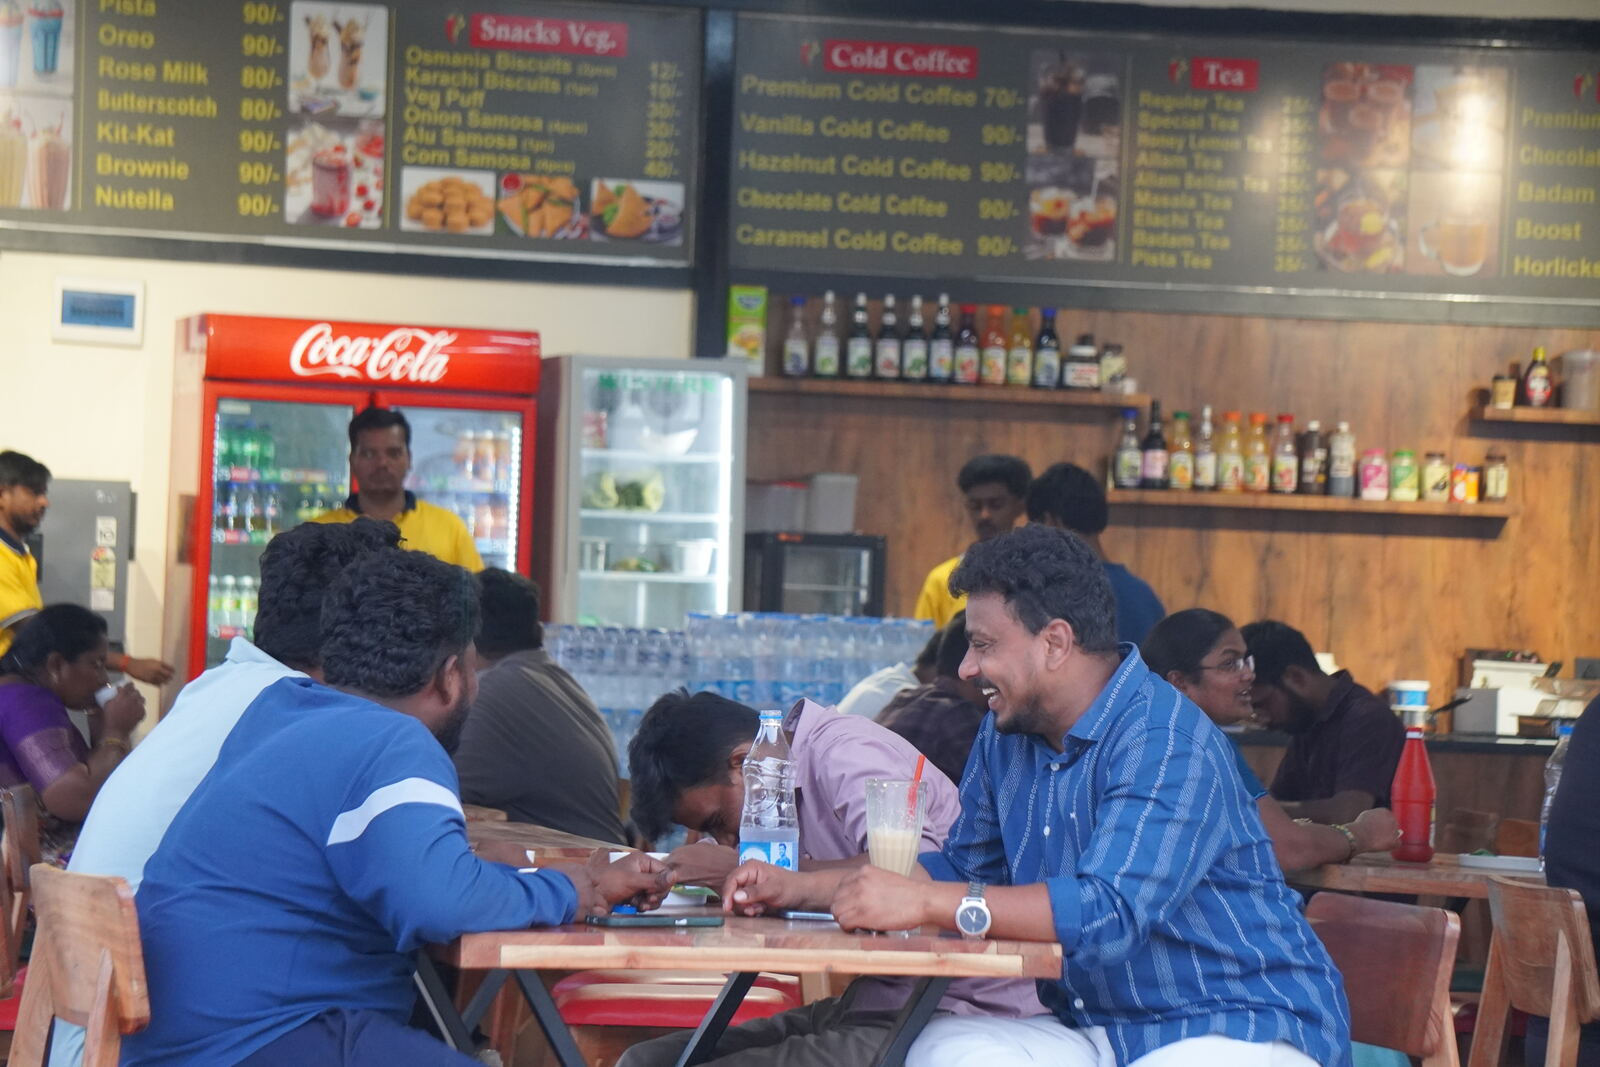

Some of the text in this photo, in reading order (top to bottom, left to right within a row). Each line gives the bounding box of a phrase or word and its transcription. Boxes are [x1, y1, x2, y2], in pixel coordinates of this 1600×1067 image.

[243, 2, 284, 25] 90/-
[99, 24, 284, 57] Oreo 90/-
[480, 17, 617, 53] Snacks Veg.
[98, 56, 283, 89] Rose Milk 80/-
[405, 45, 491, 69] Osmania
[495, 50, 573, 74] Biscuits
[830, 44, 973, 75] Cold Coffee
[1204, 62, 1245, 86] Tea
[404, 67, 479, 89] Karachi
[484, 72, 561, 94] Biscuits
[740, 75, 1024, 108] Premium Cold Coffee 70/-
[97, 88, 218, 118] Butterscotch
[403, 87, 441, 111] Veg
[445, 88, 486, 107] Puff
[1214, 93, 1245, 112] Tea
[403, 106, 462, 126] Onion
[467, 109, 543, 132] Samosa
[740, 112, 1023, 145] Vanilla Cold Coffee 90/-
[1209, 113, 1240, 132] Tea
[96, 122, 281, 153] Kit-Kat 90/-
[403, 126, 436, 145] Alu
[441, 128, 518, 151] Samosa
[96, 153, 280, 185] Brownie 90/-
[402, 144, 450, 165] Corn
[455, 148, 531, 170] Samosa
[739, 150, 1021, 183] Hazelnut Cold Coffee 90/-
[95, 186, 279, 217] Nutella 90/-
[737, 187, 1019, 219] Chocolate Cold Coffee 90/-
[1517, 181, 1595, 203] Badam
[1195, 212, 1224, 230] Tea
[1514, 217, 1582, 241] Boost
[736, 224, 1018, 257] Caramel Cold Coffee 90/-
[1201, 232, 1230, 250] Tea
[1182, 251, 1212, 269] Tea
[290, 323, 458, 382] Coca-Cola
